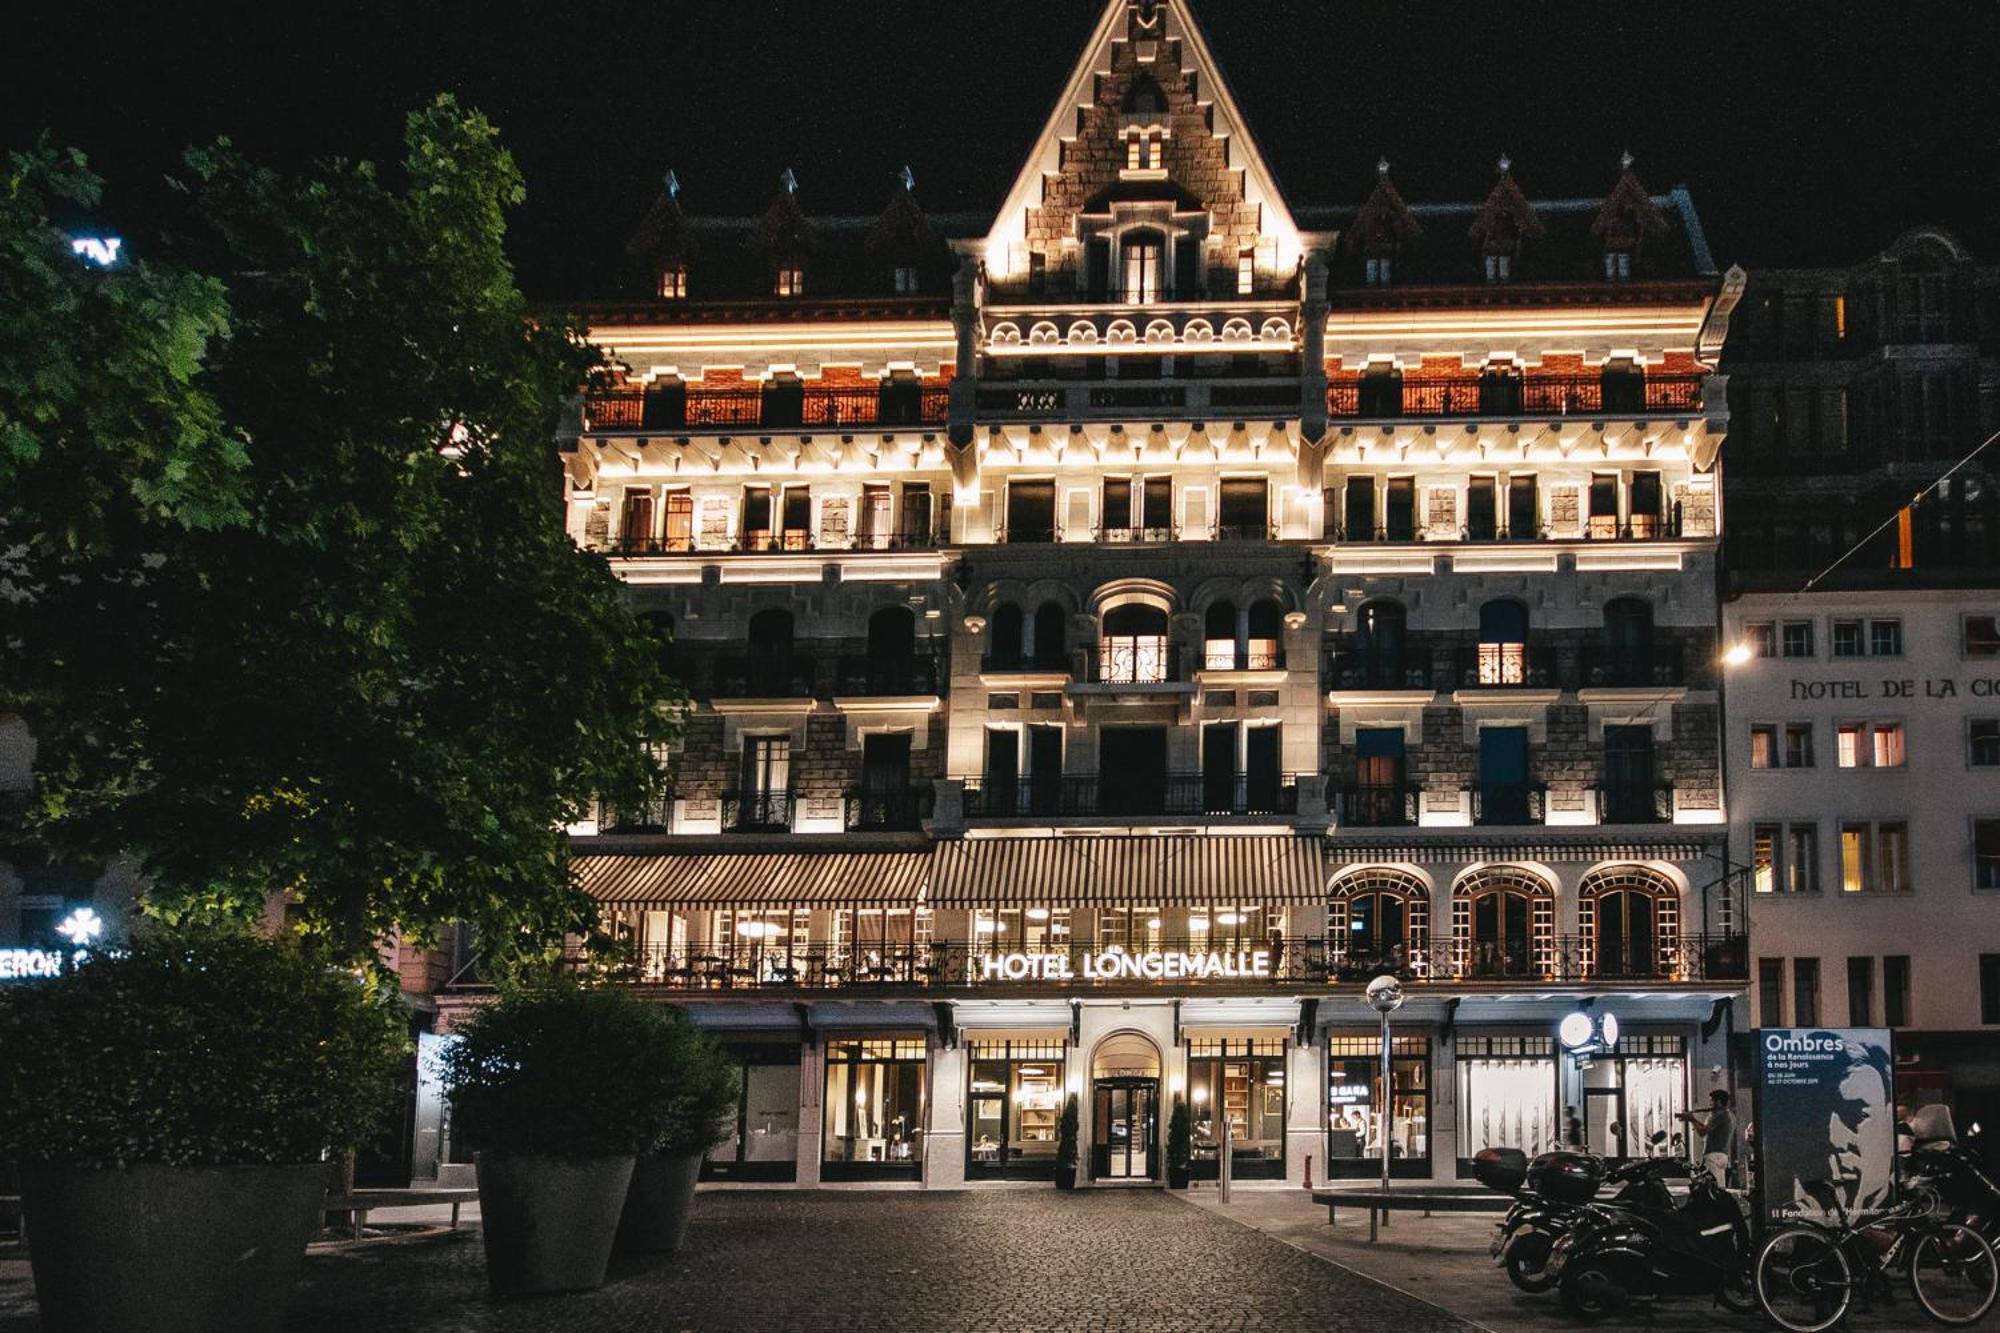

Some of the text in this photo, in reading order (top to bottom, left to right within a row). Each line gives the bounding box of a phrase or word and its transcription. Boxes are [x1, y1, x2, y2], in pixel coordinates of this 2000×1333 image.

[1881, 680, 1914, 698] DE
[1926, 679, 1957, 698] LA
[983, 951, 1269, 979] HOTEL LONGEMALLE
[1766, 1034, 1844, 1052] Ombres
[1767, 1053, 1834, 1061] de la Renaissance
